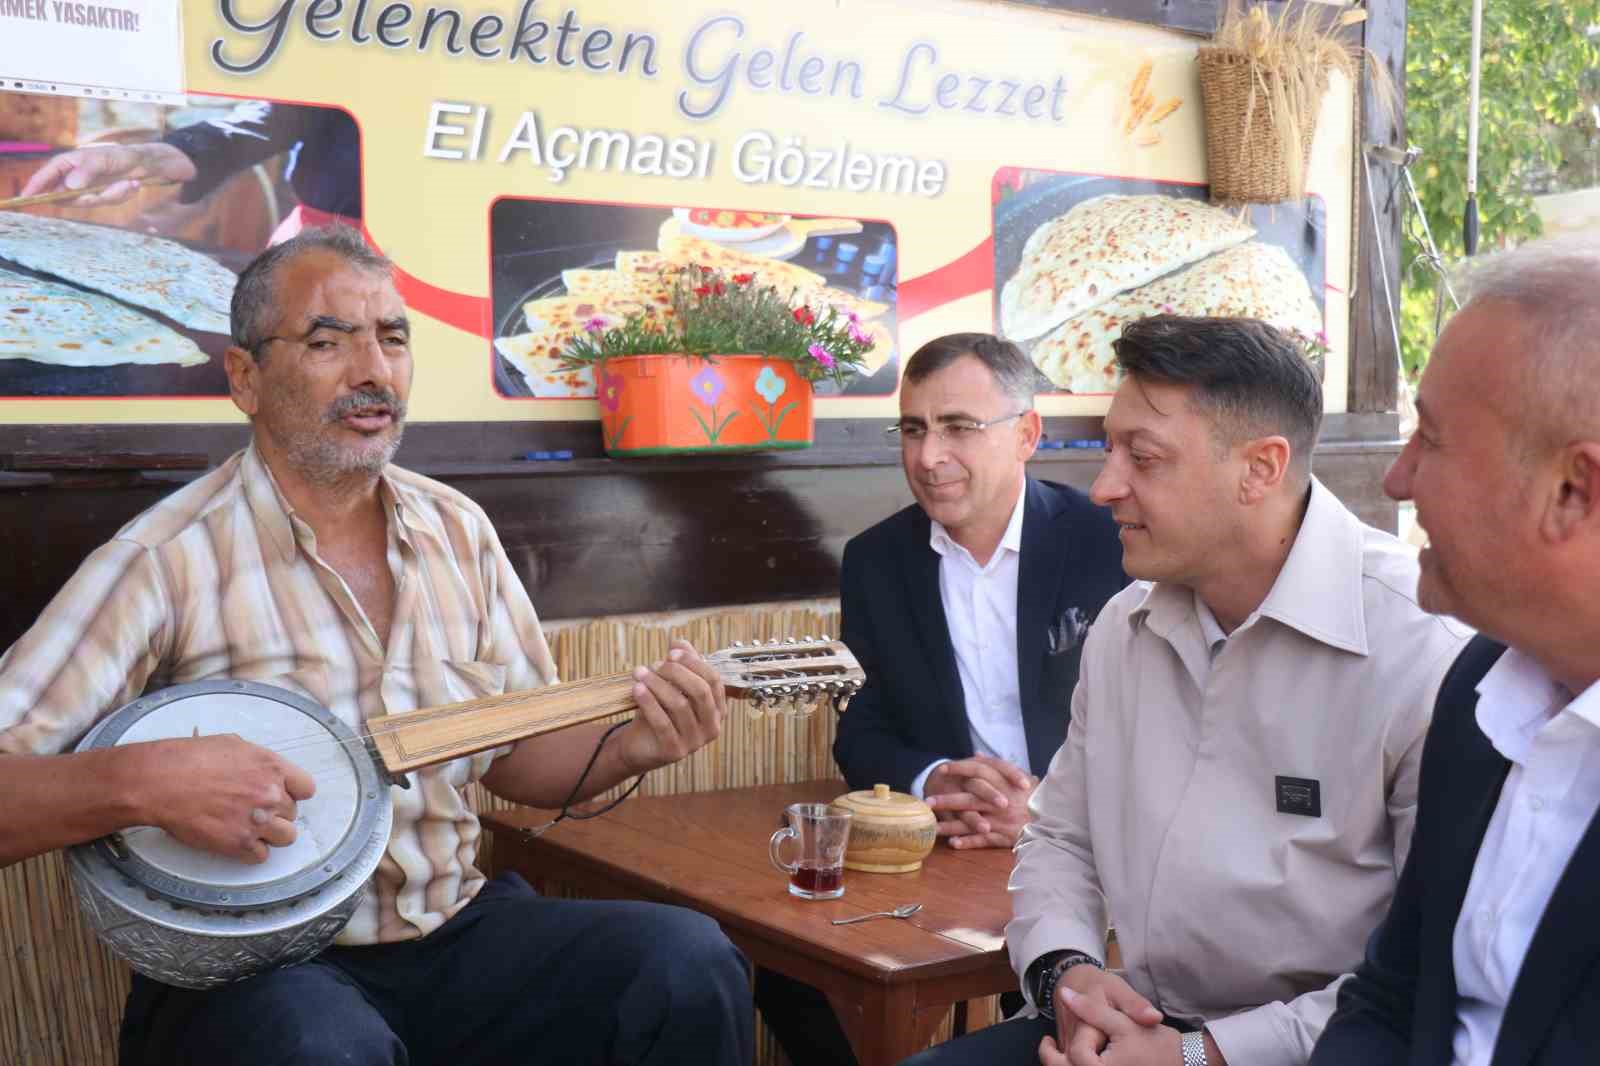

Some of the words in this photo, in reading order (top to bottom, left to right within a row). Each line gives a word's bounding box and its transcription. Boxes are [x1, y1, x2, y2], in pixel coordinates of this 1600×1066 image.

[52, 1, 140, 32] YASAKTIR!
[679, 16, 864, 118] Gelen
[878, 43, 1067, 121] Lezzet
[424, 101, 488, 161] El
[497, 111, 712, 183] Açması
[732, 130, 945, 197] Gözleme
